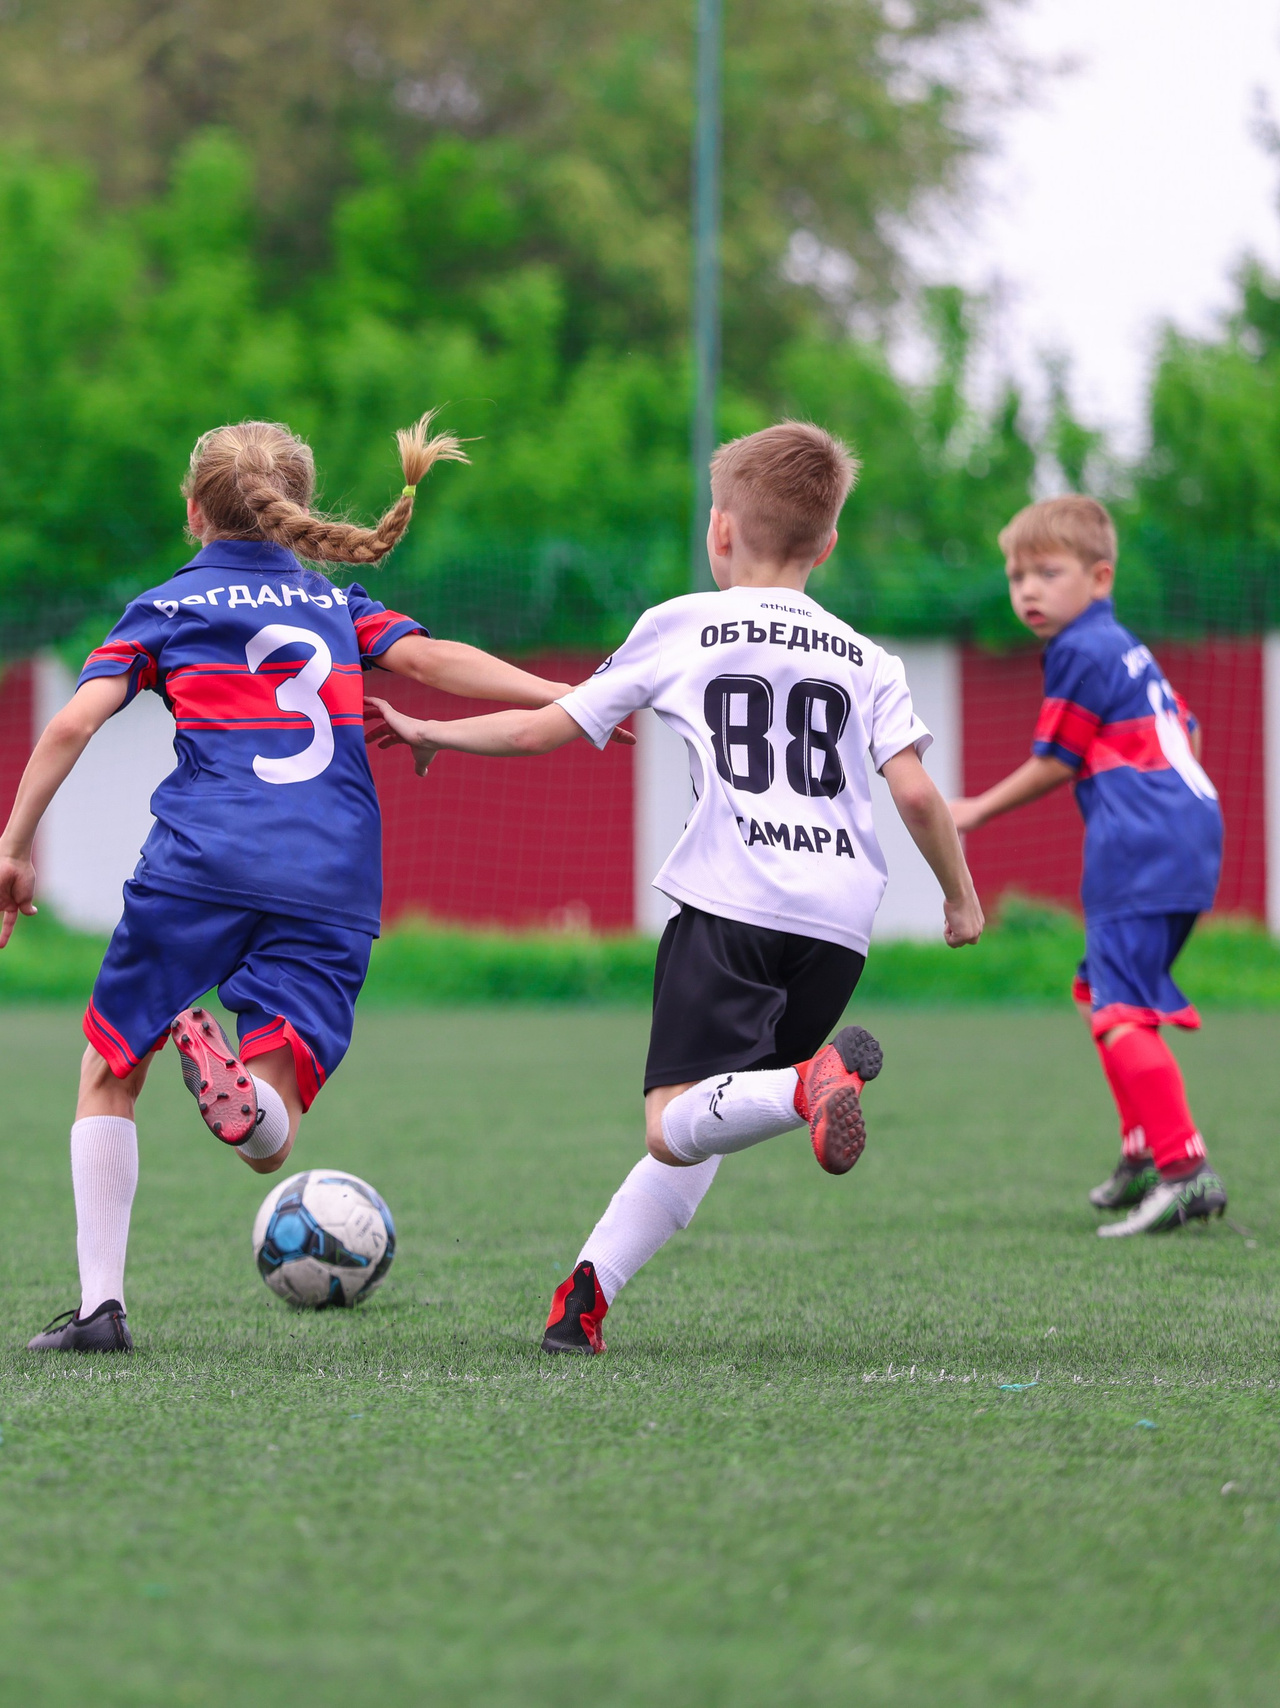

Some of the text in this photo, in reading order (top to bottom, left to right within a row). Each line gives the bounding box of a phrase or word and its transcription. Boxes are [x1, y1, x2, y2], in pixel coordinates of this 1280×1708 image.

[700, 620, 863, 667] ОБЪЕДКОВ
[245, 624, 335, 784] 3
[703, 674, 851, 800] 88
[736, 816, 855, 859] АМАРА
